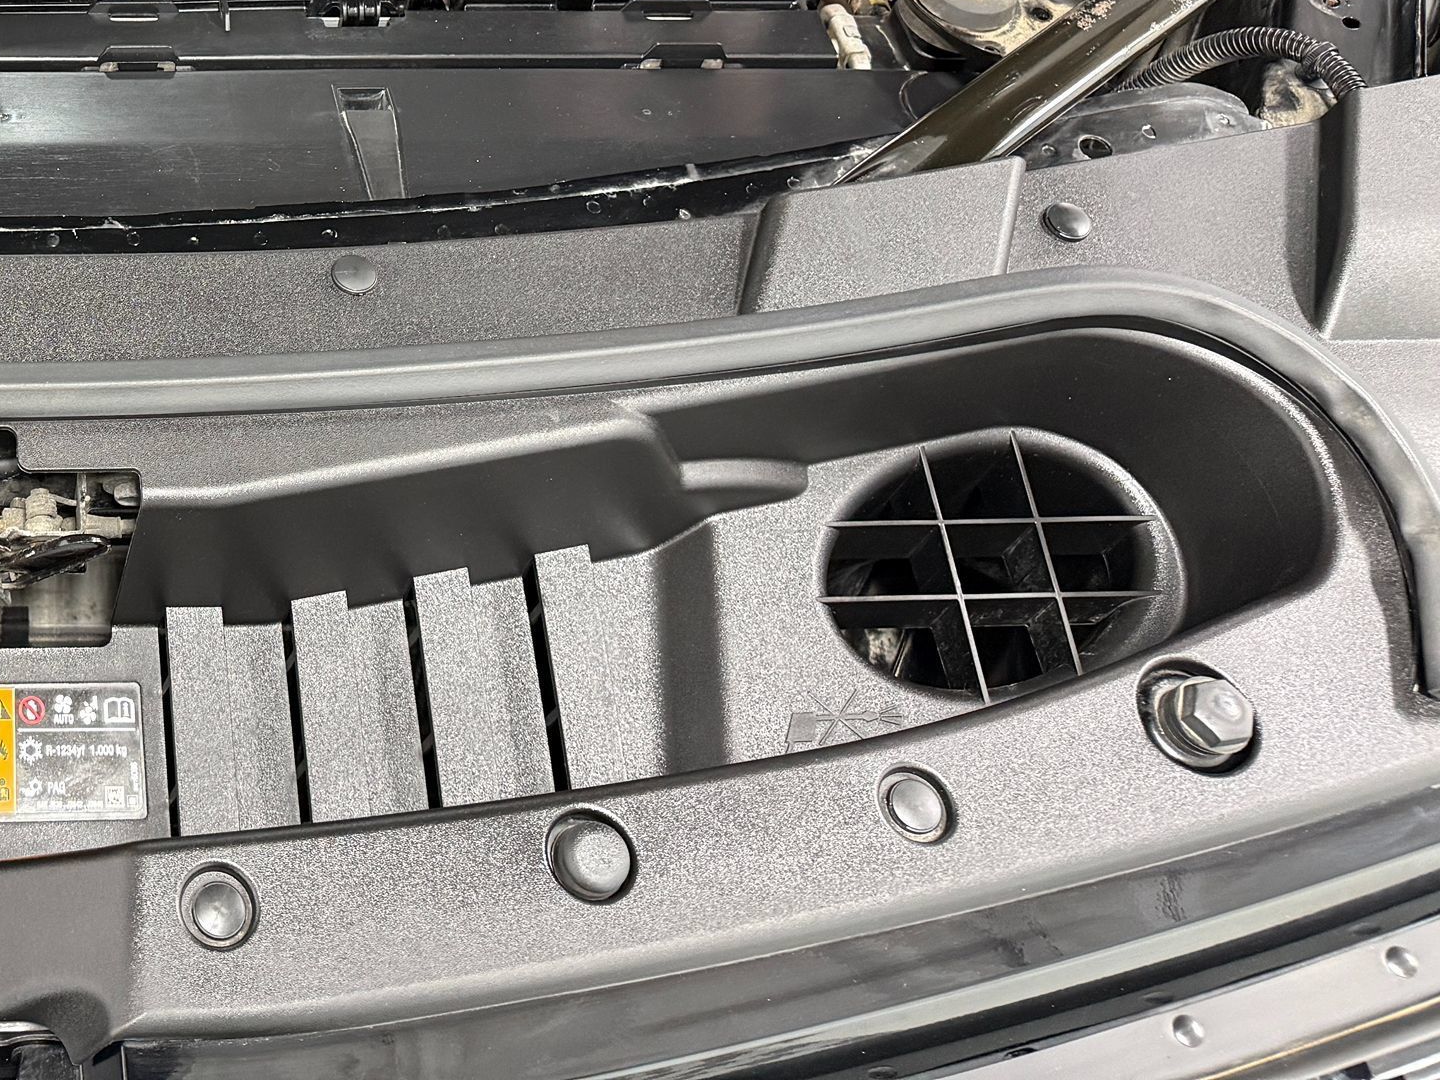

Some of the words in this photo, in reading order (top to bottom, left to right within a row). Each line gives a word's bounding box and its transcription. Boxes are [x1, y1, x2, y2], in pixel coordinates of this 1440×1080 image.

[53, 715, 74, 725] AUTO
[46, 744, 86, 758] R-1234yf
[90, 744, 114, 756] 1.000
[115, 744, 128, 758] kg
